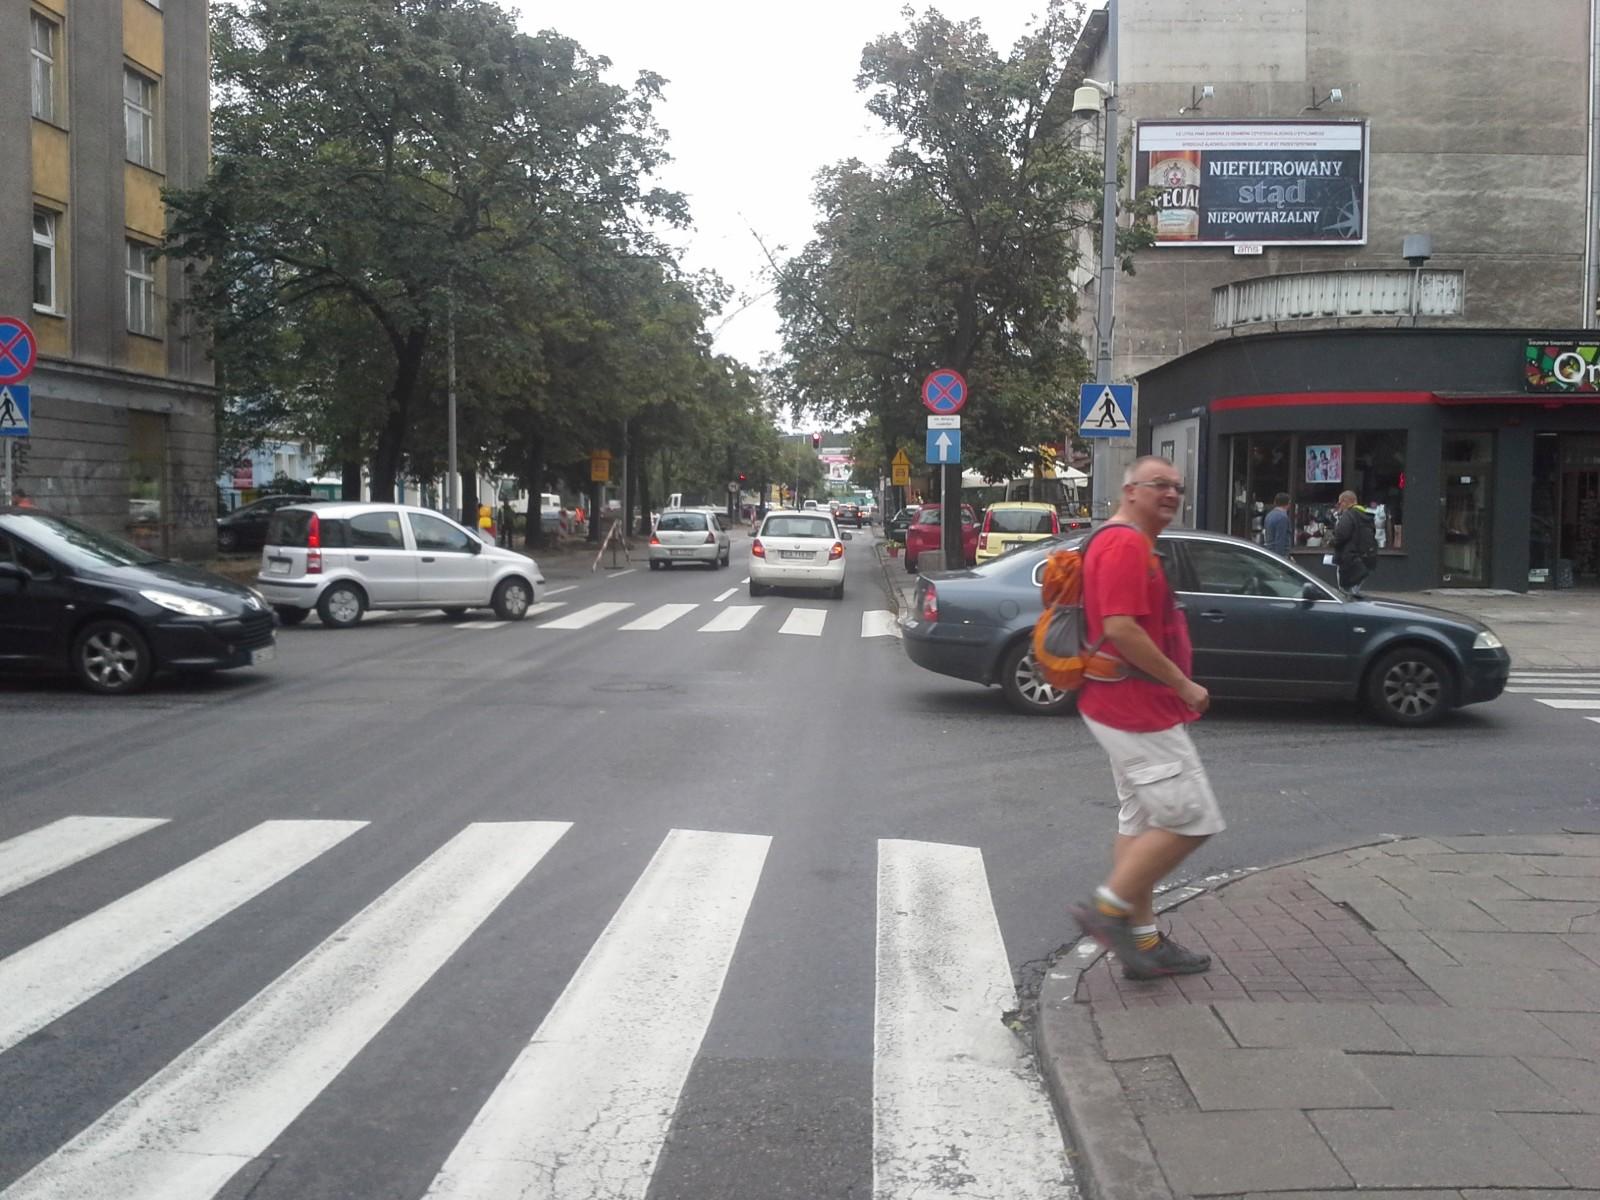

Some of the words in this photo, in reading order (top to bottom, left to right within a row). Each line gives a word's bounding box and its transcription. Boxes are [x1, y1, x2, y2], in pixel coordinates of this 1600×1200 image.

[1209, 161, 1343, 176] NIEFILTROWANY
[1239, 179, 1306, 208] stąd
[1207, 211, 1320, 224] NIEPOWTARZALNY
